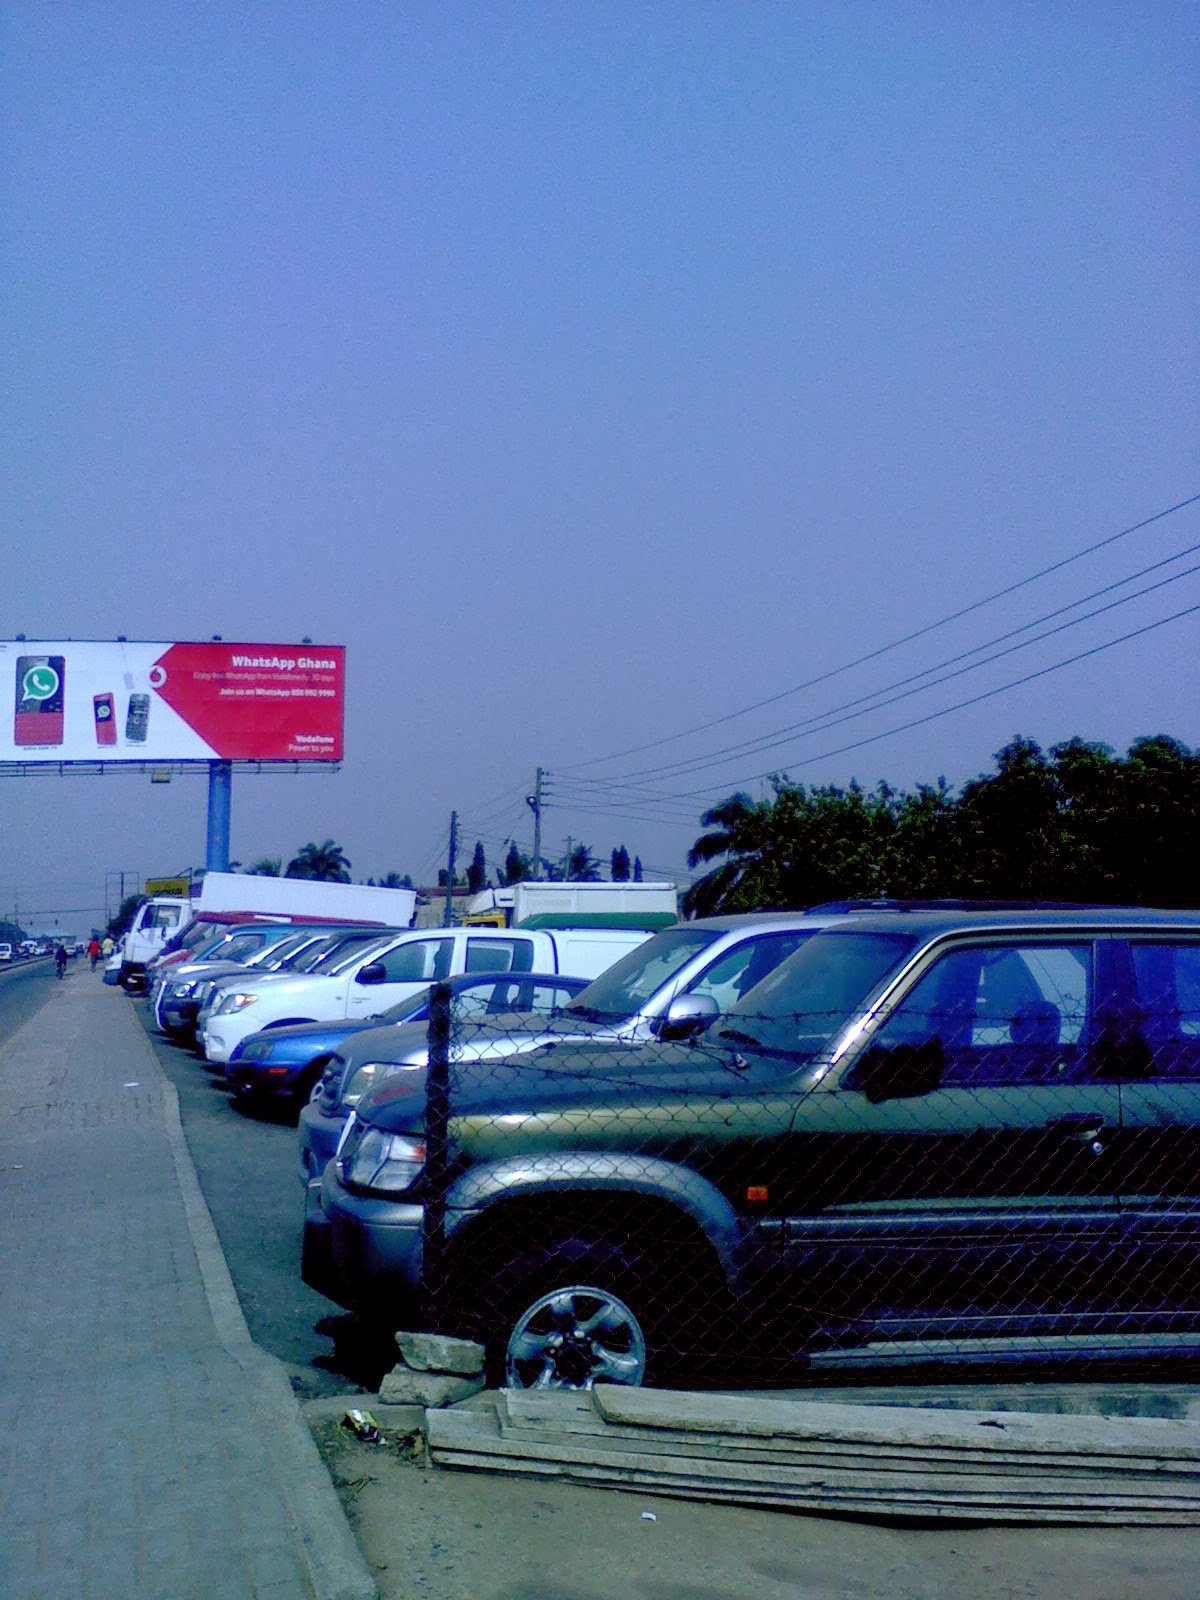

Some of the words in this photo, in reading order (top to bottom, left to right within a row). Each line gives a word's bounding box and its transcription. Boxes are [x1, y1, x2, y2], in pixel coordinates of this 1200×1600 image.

[231, 656, 295, 670] WhatsApp
[297, 658, 336, 669] Ghana
[255, 688, 290, 697] WhatsApp
[295, 735, 334, 743] Vodafone
[288, 743, 310, 751] Power
